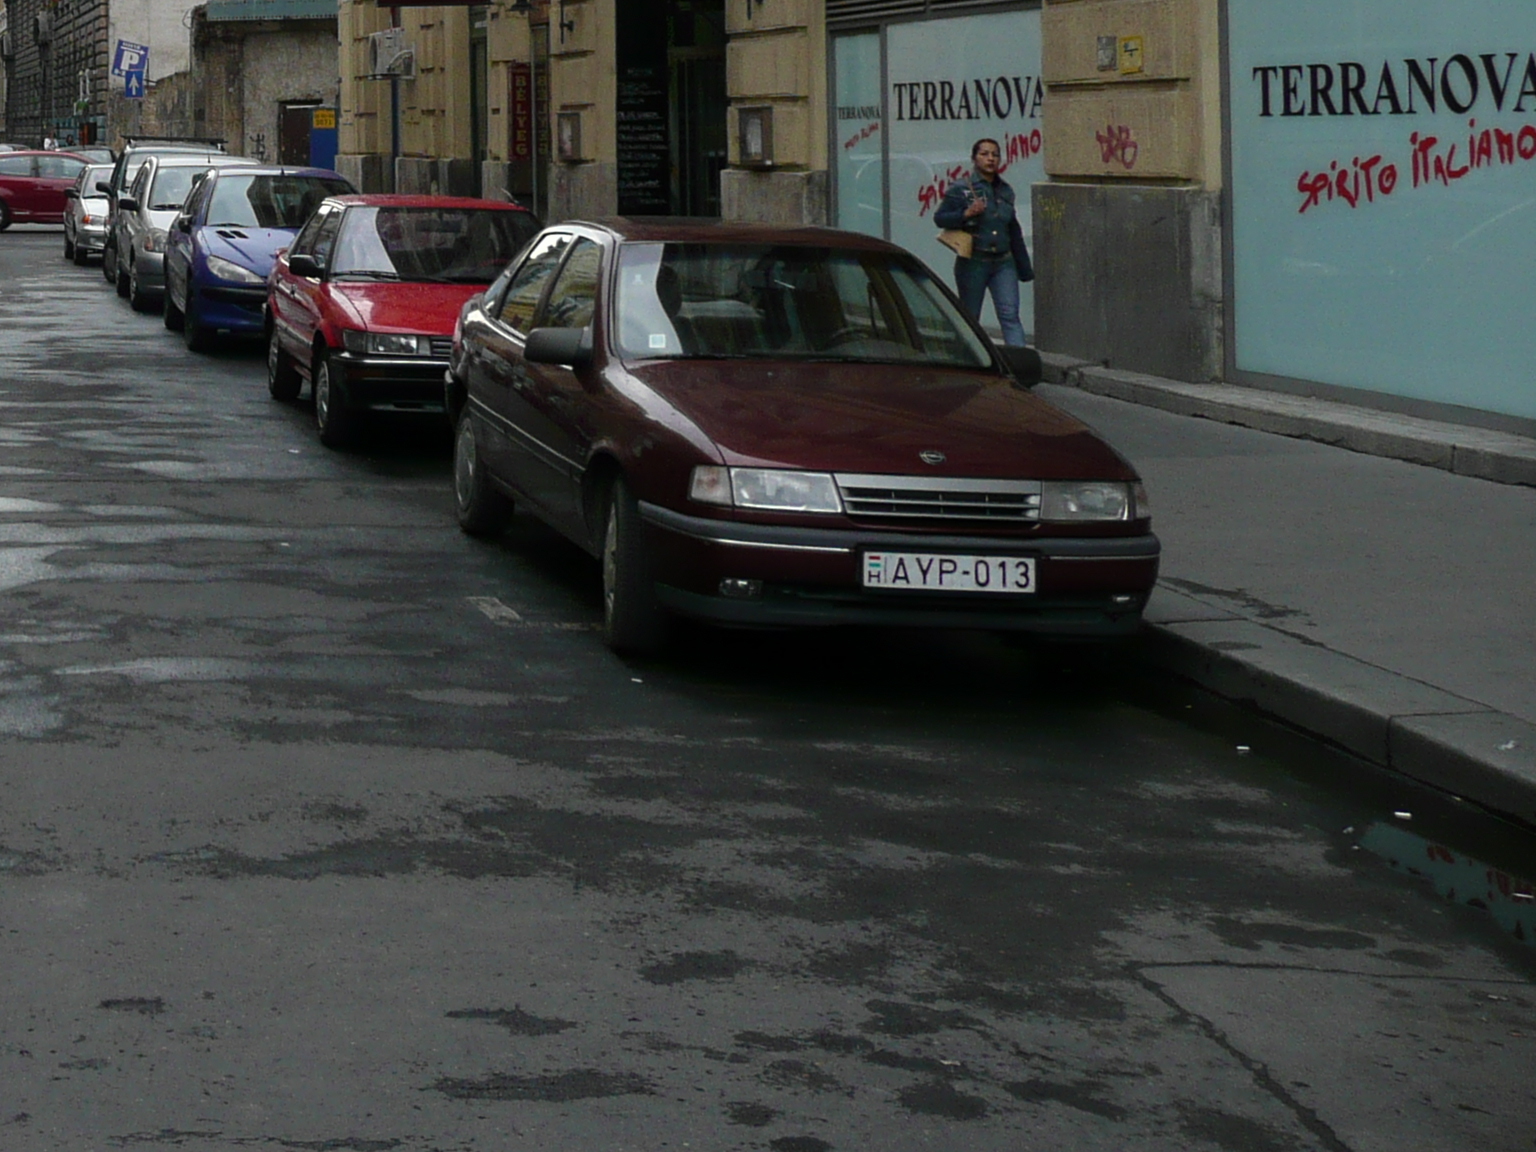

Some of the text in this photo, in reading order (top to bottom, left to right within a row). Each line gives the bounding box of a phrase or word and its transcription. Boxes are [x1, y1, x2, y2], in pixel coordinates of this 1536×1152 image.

[120, 50, 140, 71] P
[893, 76, 1044, 121] TERRANOVA
[1253, 53, 1536, 117] TERRANOVA
[892, 557, 1030, 588] AYP-013
